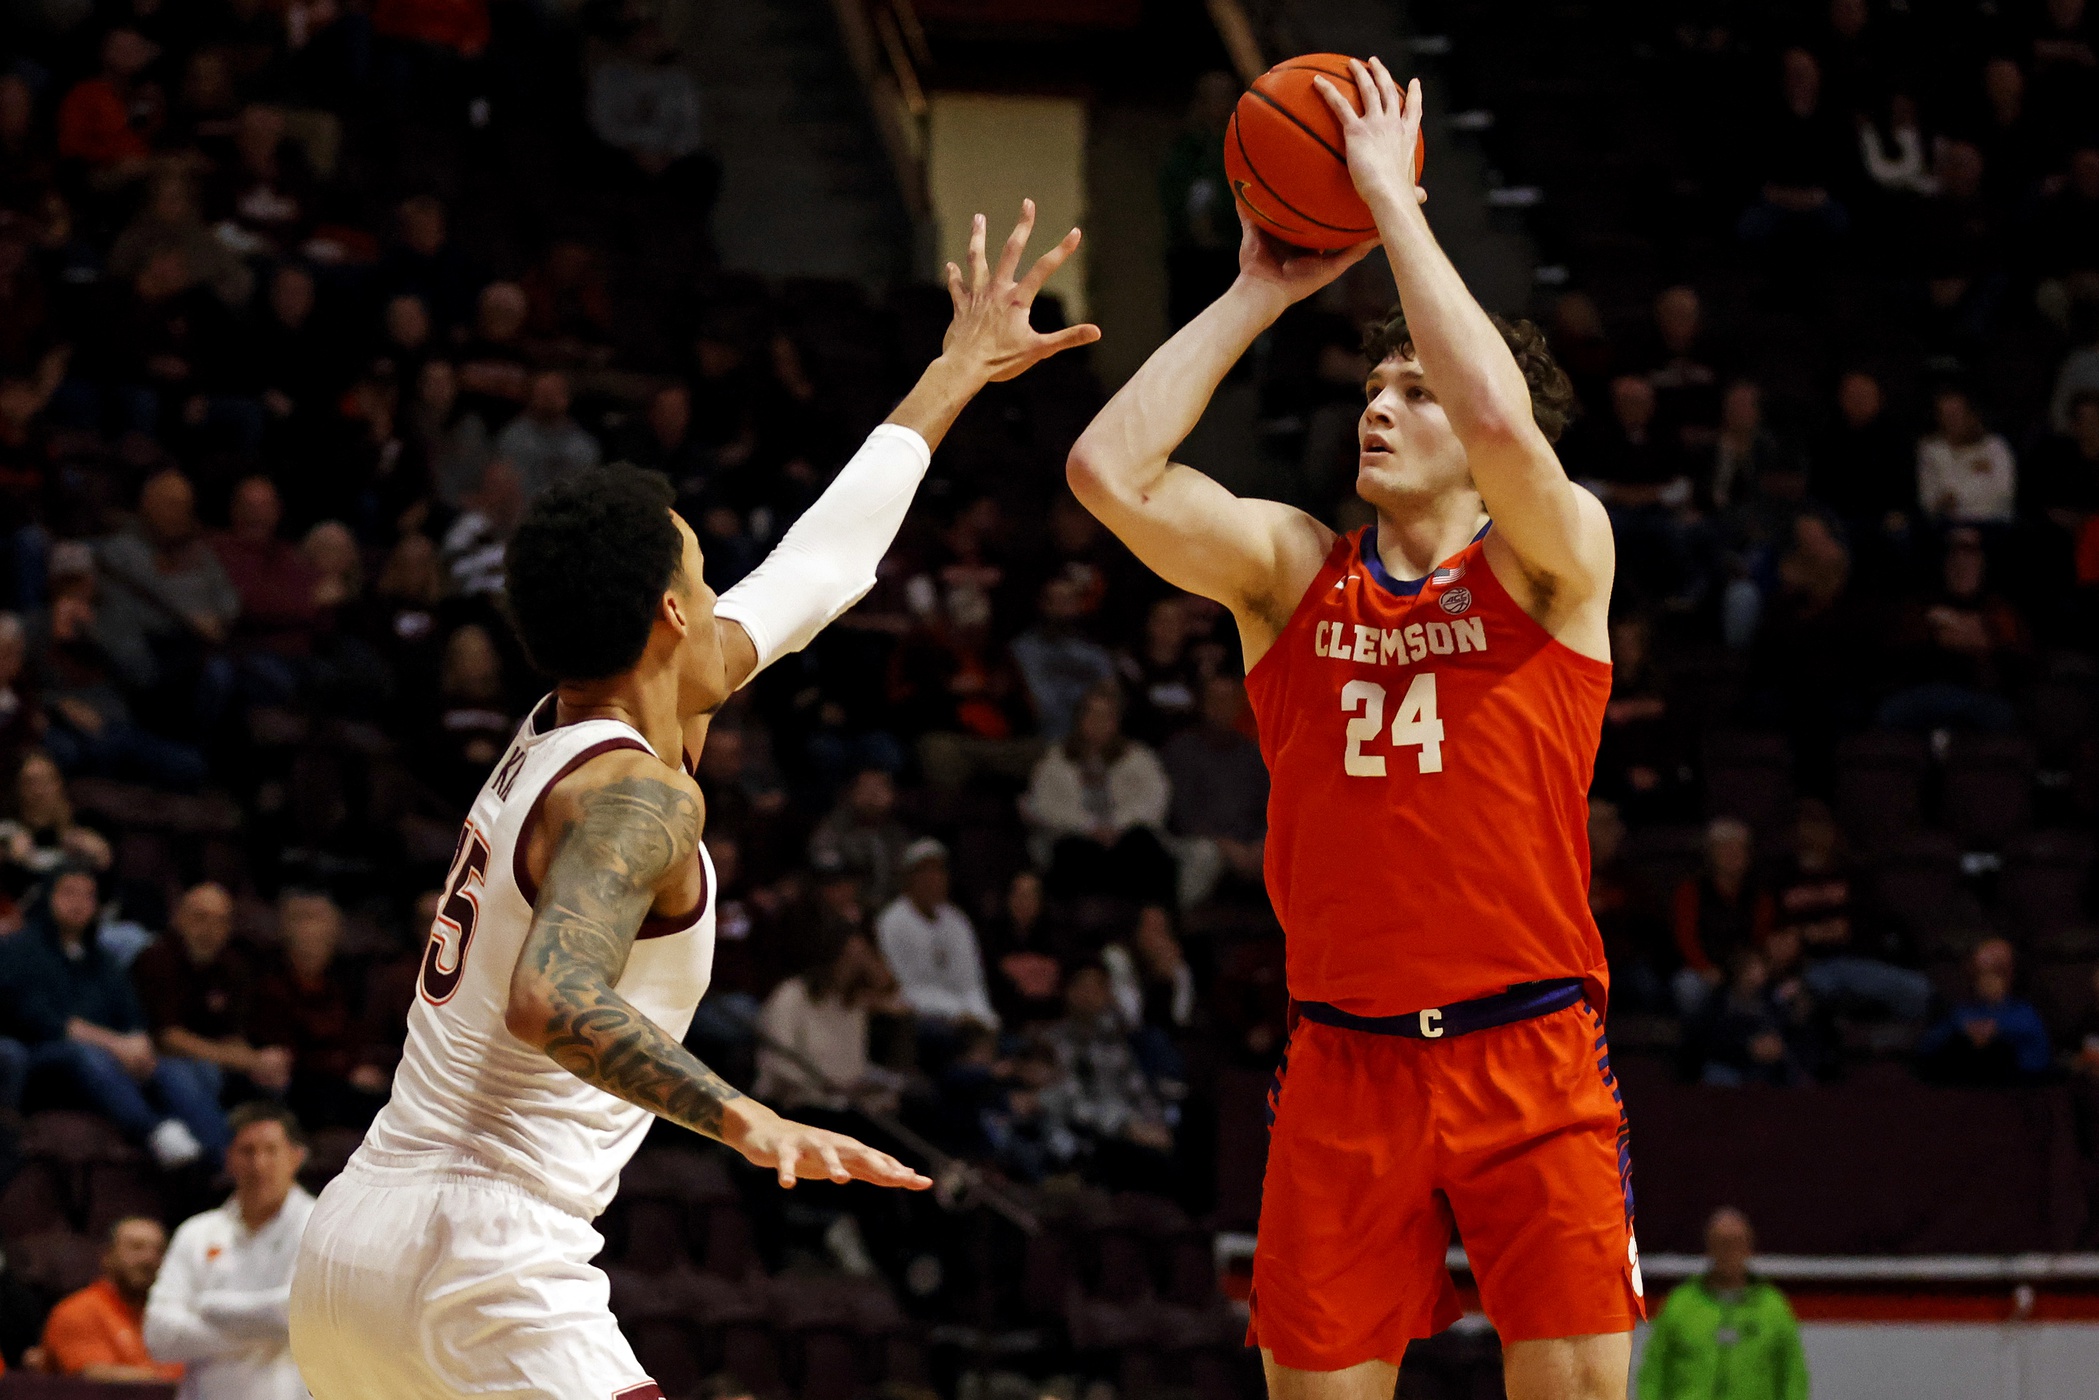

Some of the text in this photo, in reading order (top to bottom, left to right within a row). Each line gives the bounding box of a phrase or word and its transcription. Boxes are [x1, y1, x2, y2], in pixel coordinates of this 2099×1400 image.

[1315, 617, 1487, 665] CLEMSON
[1341, 673, 1445, 777] 24
[1419, 1009, 1444, 1038] C
